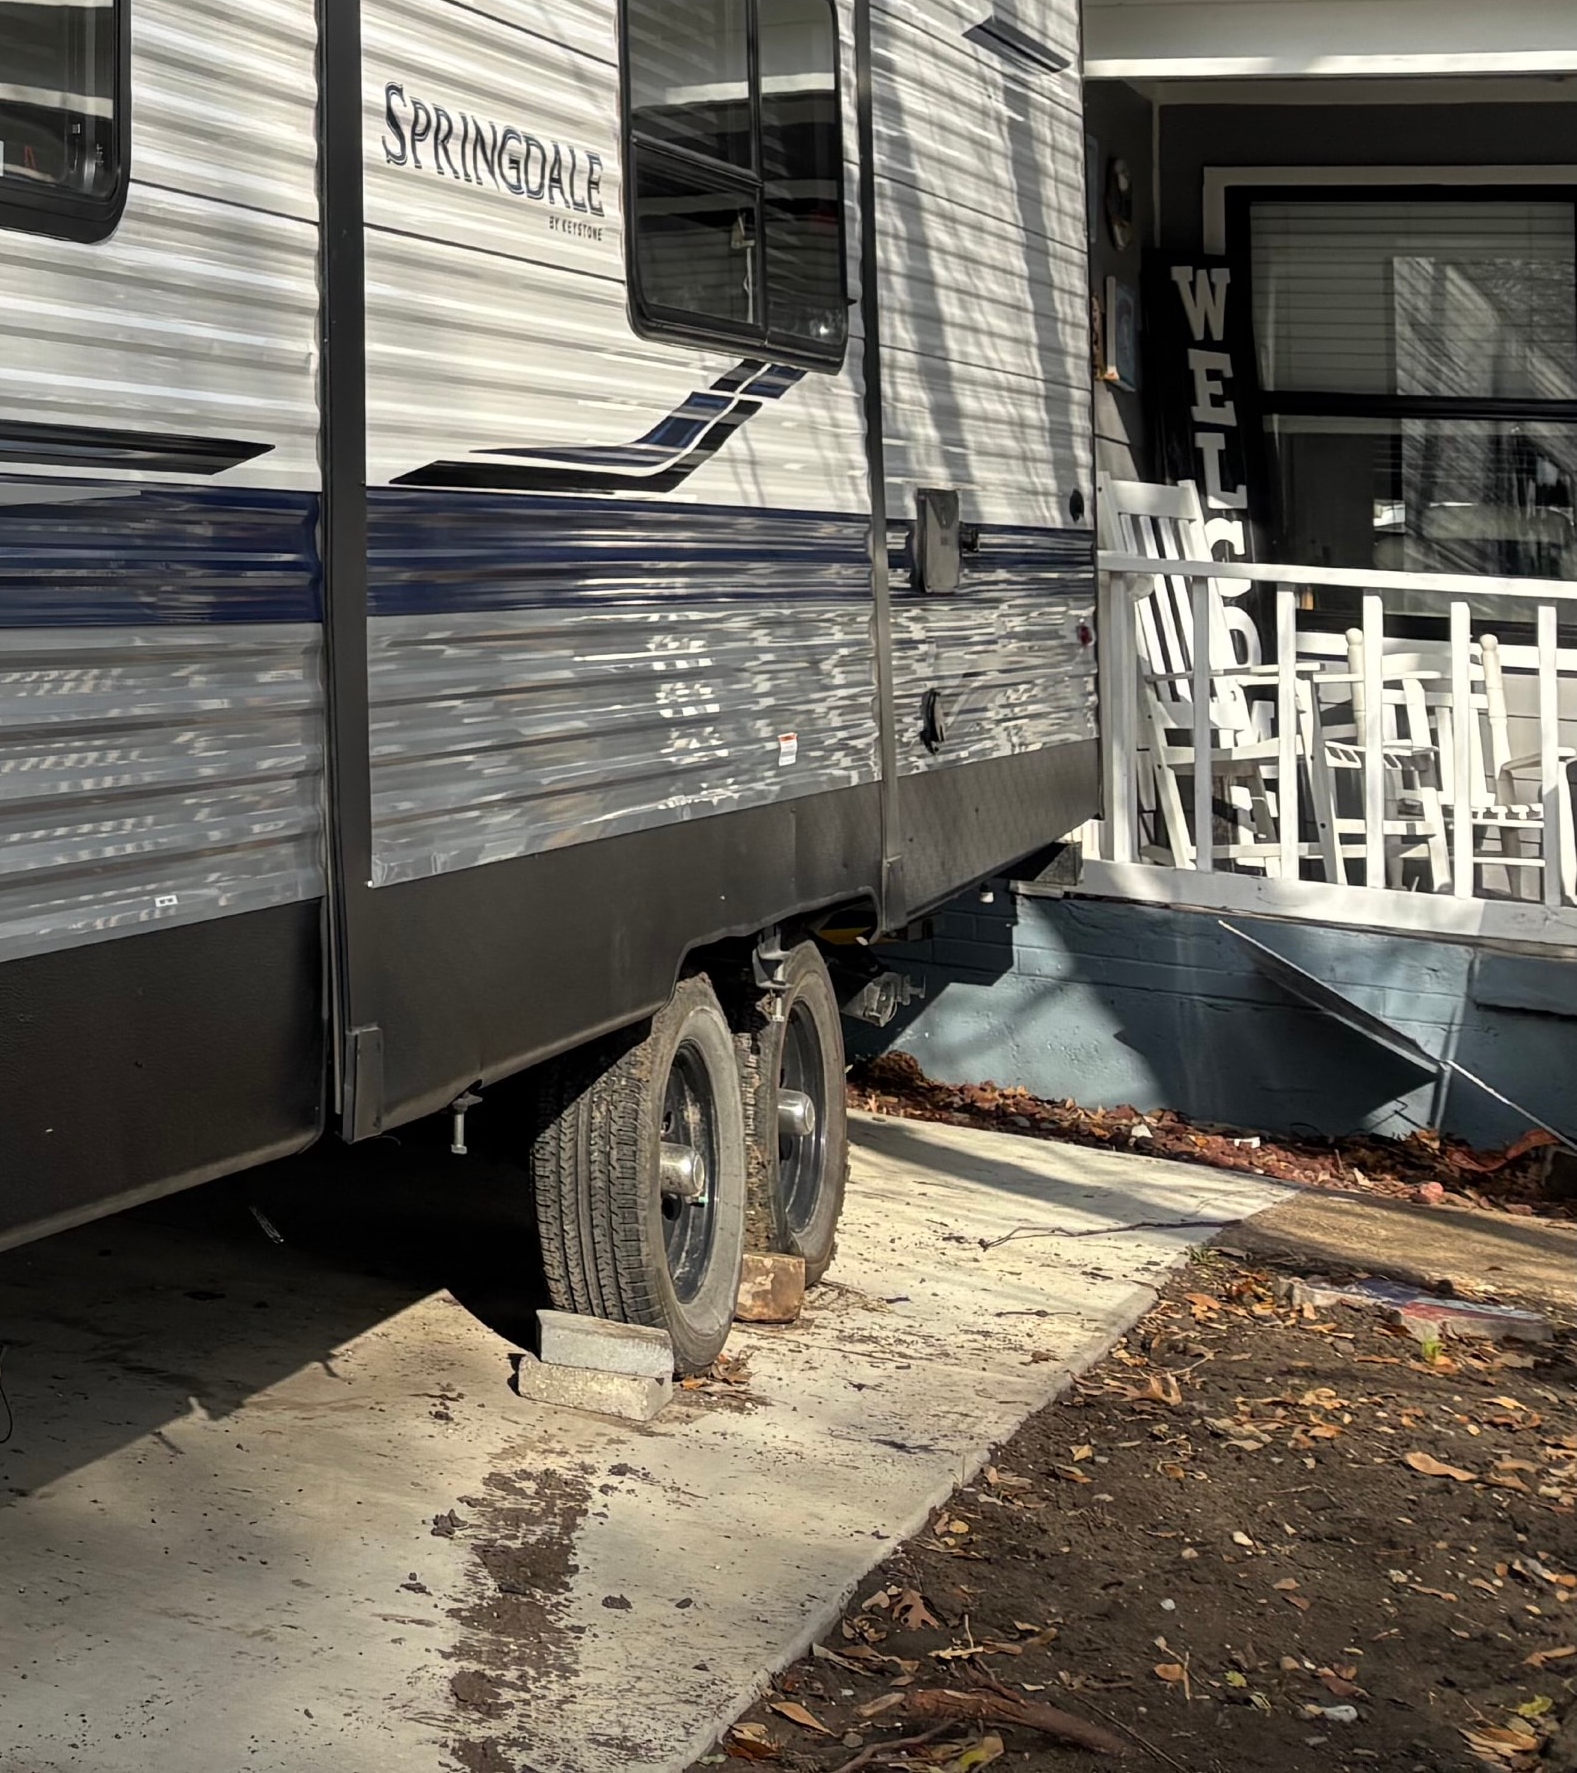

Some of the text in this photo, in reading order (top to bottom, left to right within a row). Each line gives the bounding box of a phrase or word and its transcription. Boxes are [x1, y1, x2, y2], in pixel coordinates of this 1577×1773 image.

[381, 81, 605, 217] SPRINGDALE
[549, 215, 602, 241] BY KEYSTONE
